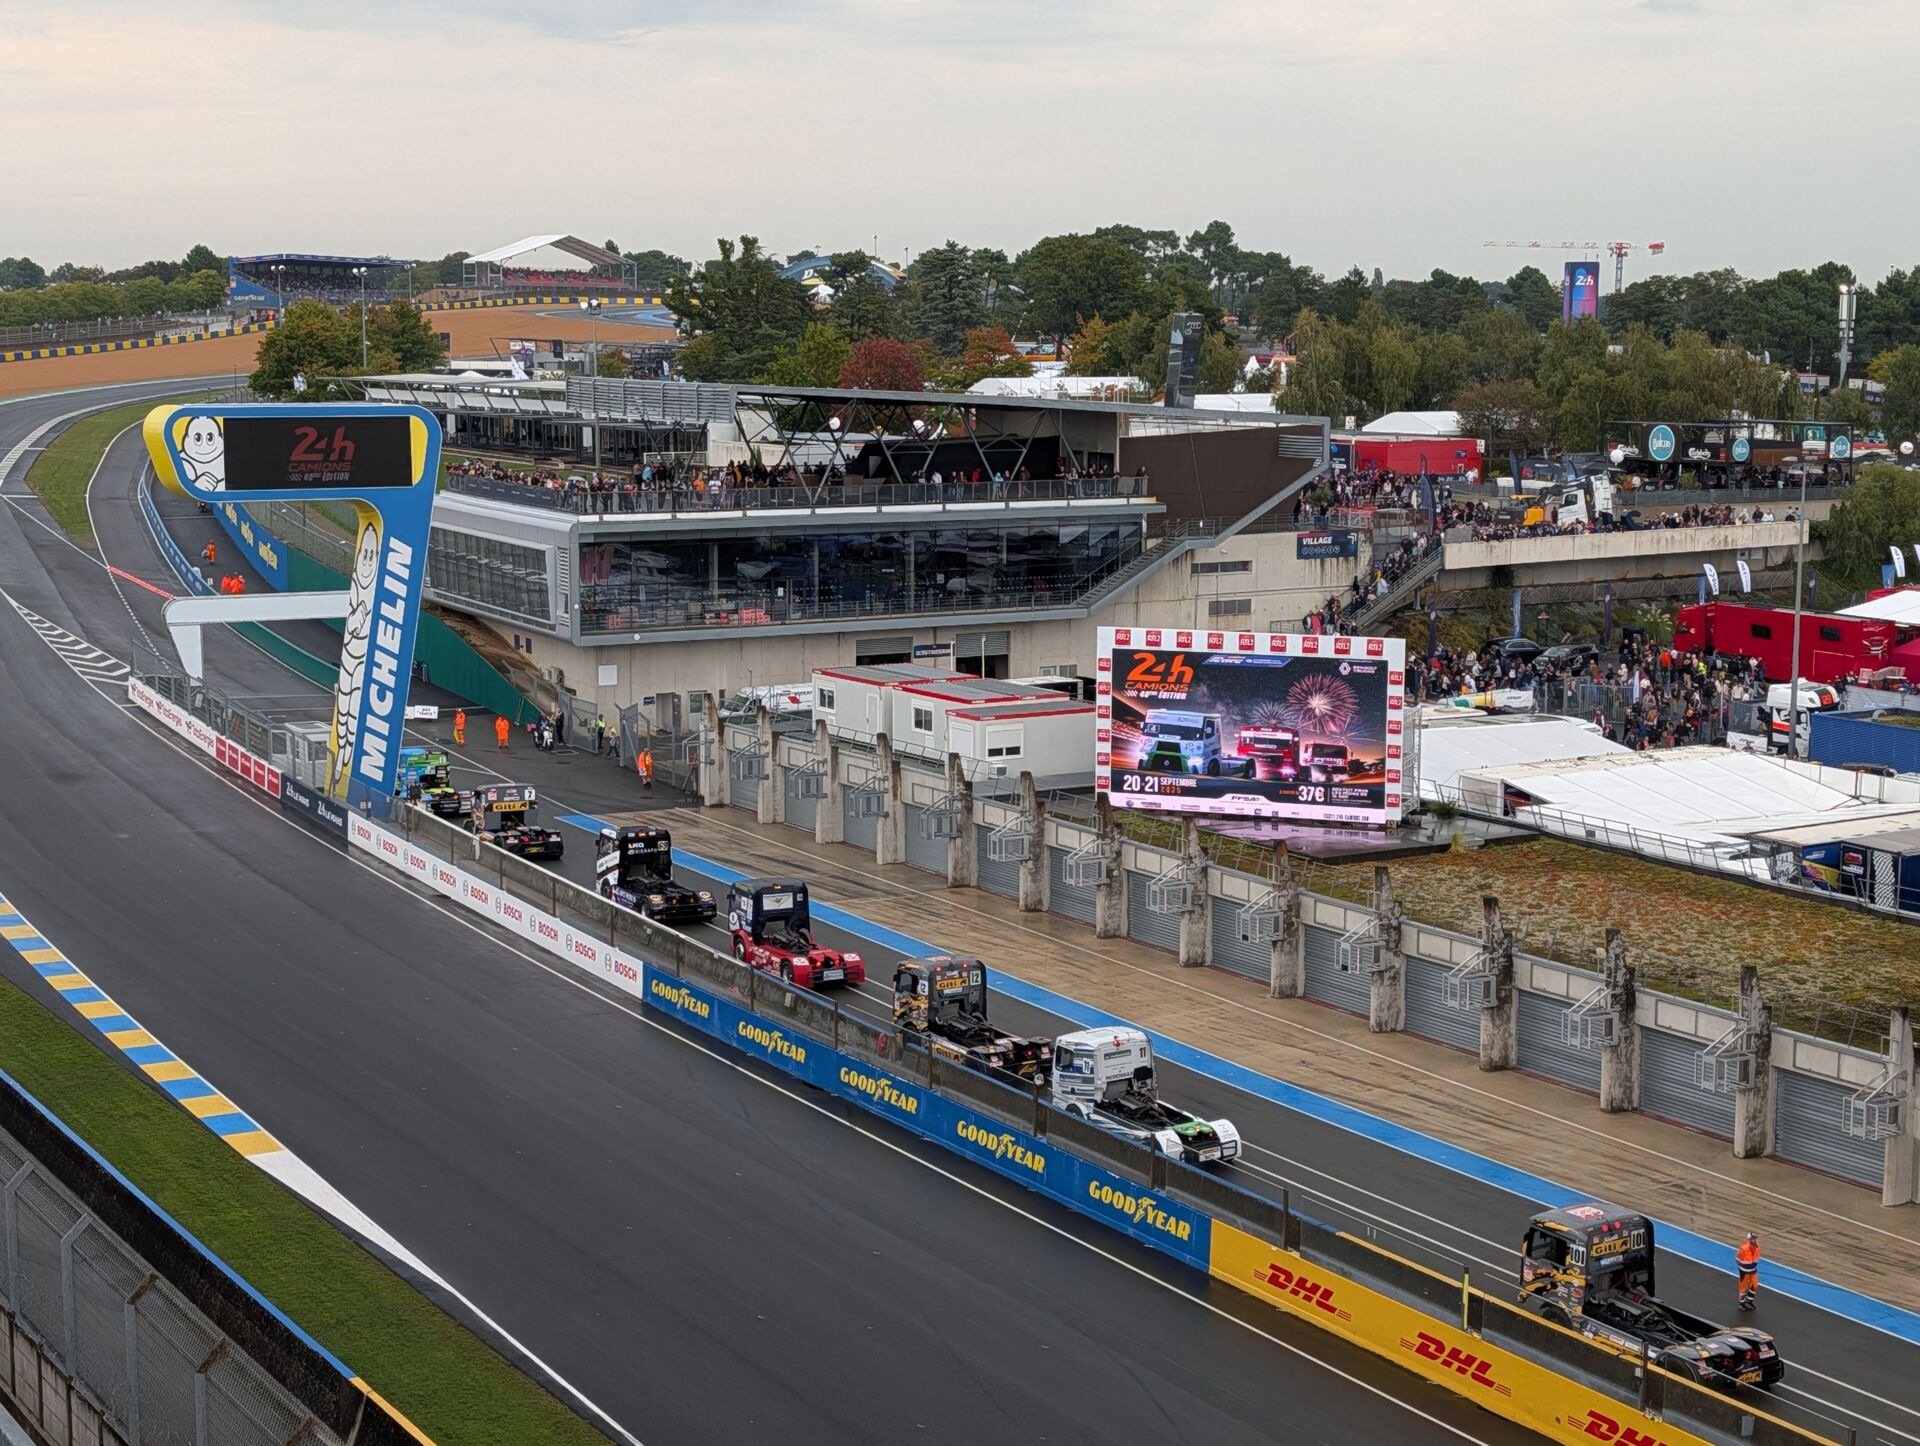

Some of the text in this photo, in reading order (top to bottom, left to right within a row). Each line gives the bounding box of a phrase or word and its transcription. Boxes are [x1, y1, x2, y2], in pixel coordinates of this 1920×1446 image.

[290, 425, 356, 461] 24h
[288, 462, 352, 472] CAMIONS
[1302, 536, 1332, 545] VILLAGE
[360, 536, 413, 782] MICHELIN
[1126, 652, 1194, 683] 24h
[1125, 681, 1189, 692] CAMIONS
[1160, 777, 1197, 787] SEPTEMBRE
[527, 790, 533, 799] 7
[1298, 785, 1325, 801] 37€
[357, 825, 371, 842] BOSCH
[382, 839, 398, 856] BOSCH
[410, 854, 426, 872] BOSCH
[439, 870, 457, 888] BOSCH
[470, 885, 489, 905] BOSCH
[503, 902, 523, 923] BOSCH
[538, 920, 558, 942] BOSCH
[574, 940, 596, 962] BOSCH
[614, 960, 638, 982] BOSCH
[971, 971, 980, 984] 12
[651, 978, 710, 1019] GOODYEAR
[738, 1020, 806, 1065] GOODYEAR
[1139, 1047, 1147, 1058] 11
[1083, 1059, 1090, 1073] 11
[839, 1066, 918, 1115] GOODYEAR
[956, 1119, 1047, 1174] GOODYEAR
[1088, 1179, 1192, 1243] GOODYEAR
[1595, 1243, 1617, 1255] Giti
[1631, 1230, 1646, 1248] 101
[1570, 1245, 1585, 1266] 101
[1266, 1262, 1340, 1316] DHL
[1413, 1330, 1499, 1386] DHL
[1584, 1409, 1668, 1446] DH
